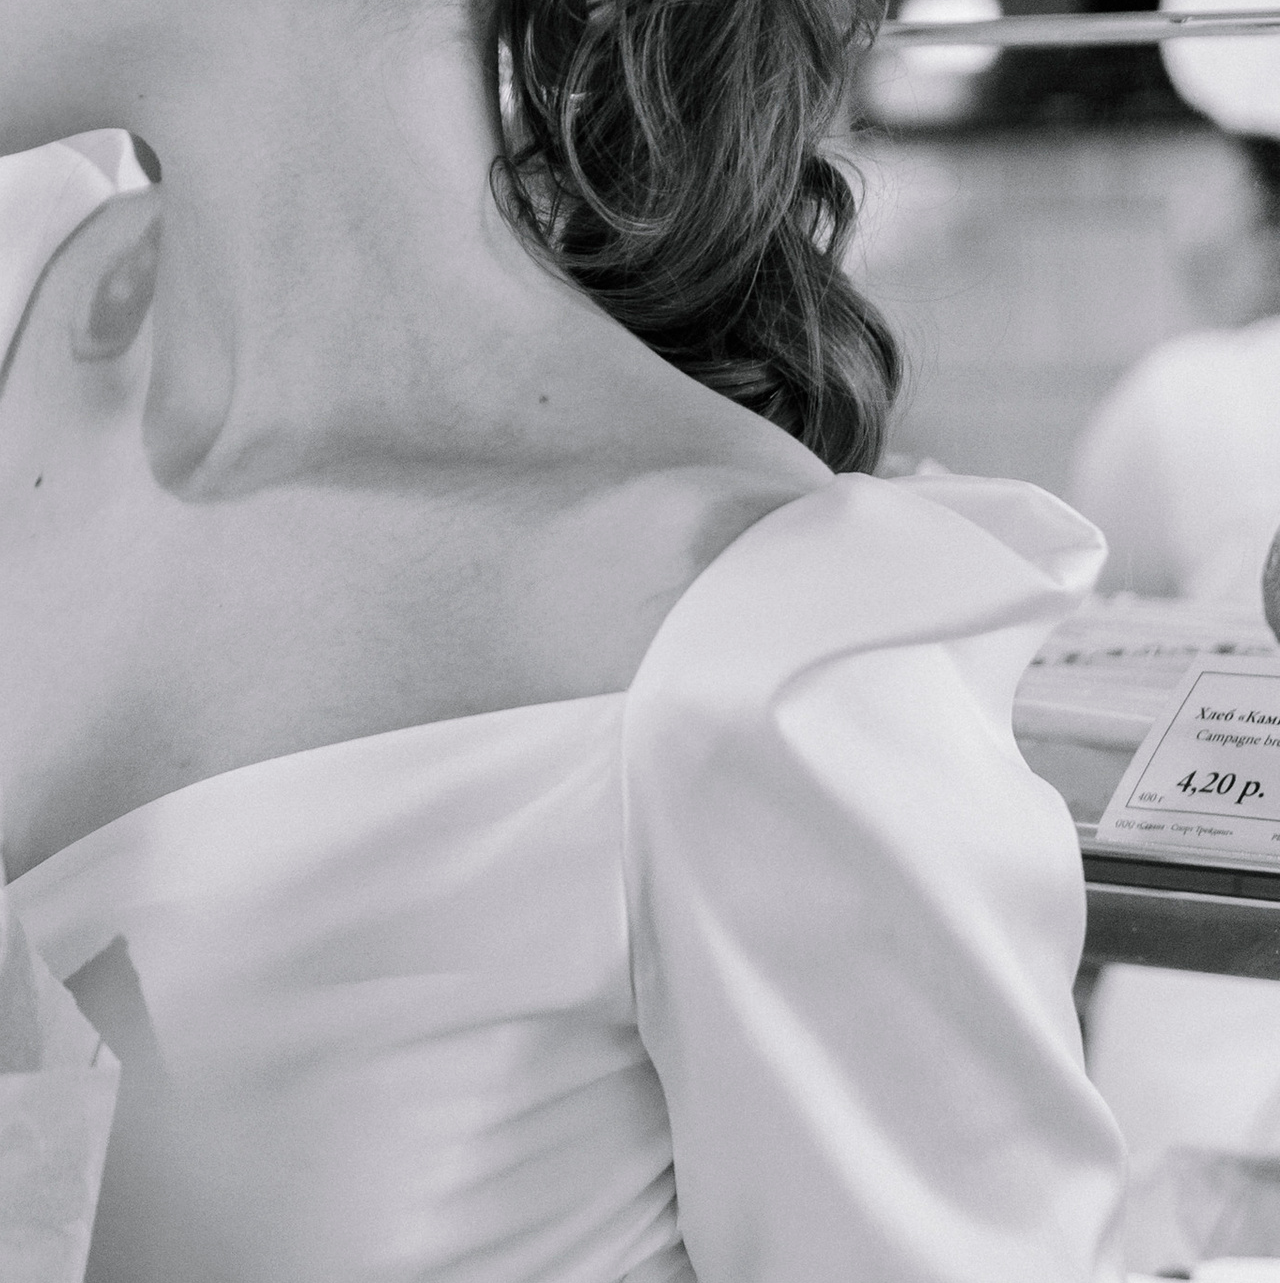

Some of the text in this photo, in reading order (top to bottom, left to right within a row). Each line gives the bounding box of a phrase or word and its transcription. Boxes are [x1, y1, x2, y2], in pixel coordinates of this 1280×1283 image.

[1195, 706, 1237, 721] Хлеб
[1196, 729, 1262, 748] Campagne
[1176, 770, 1237, 797] 4,20
